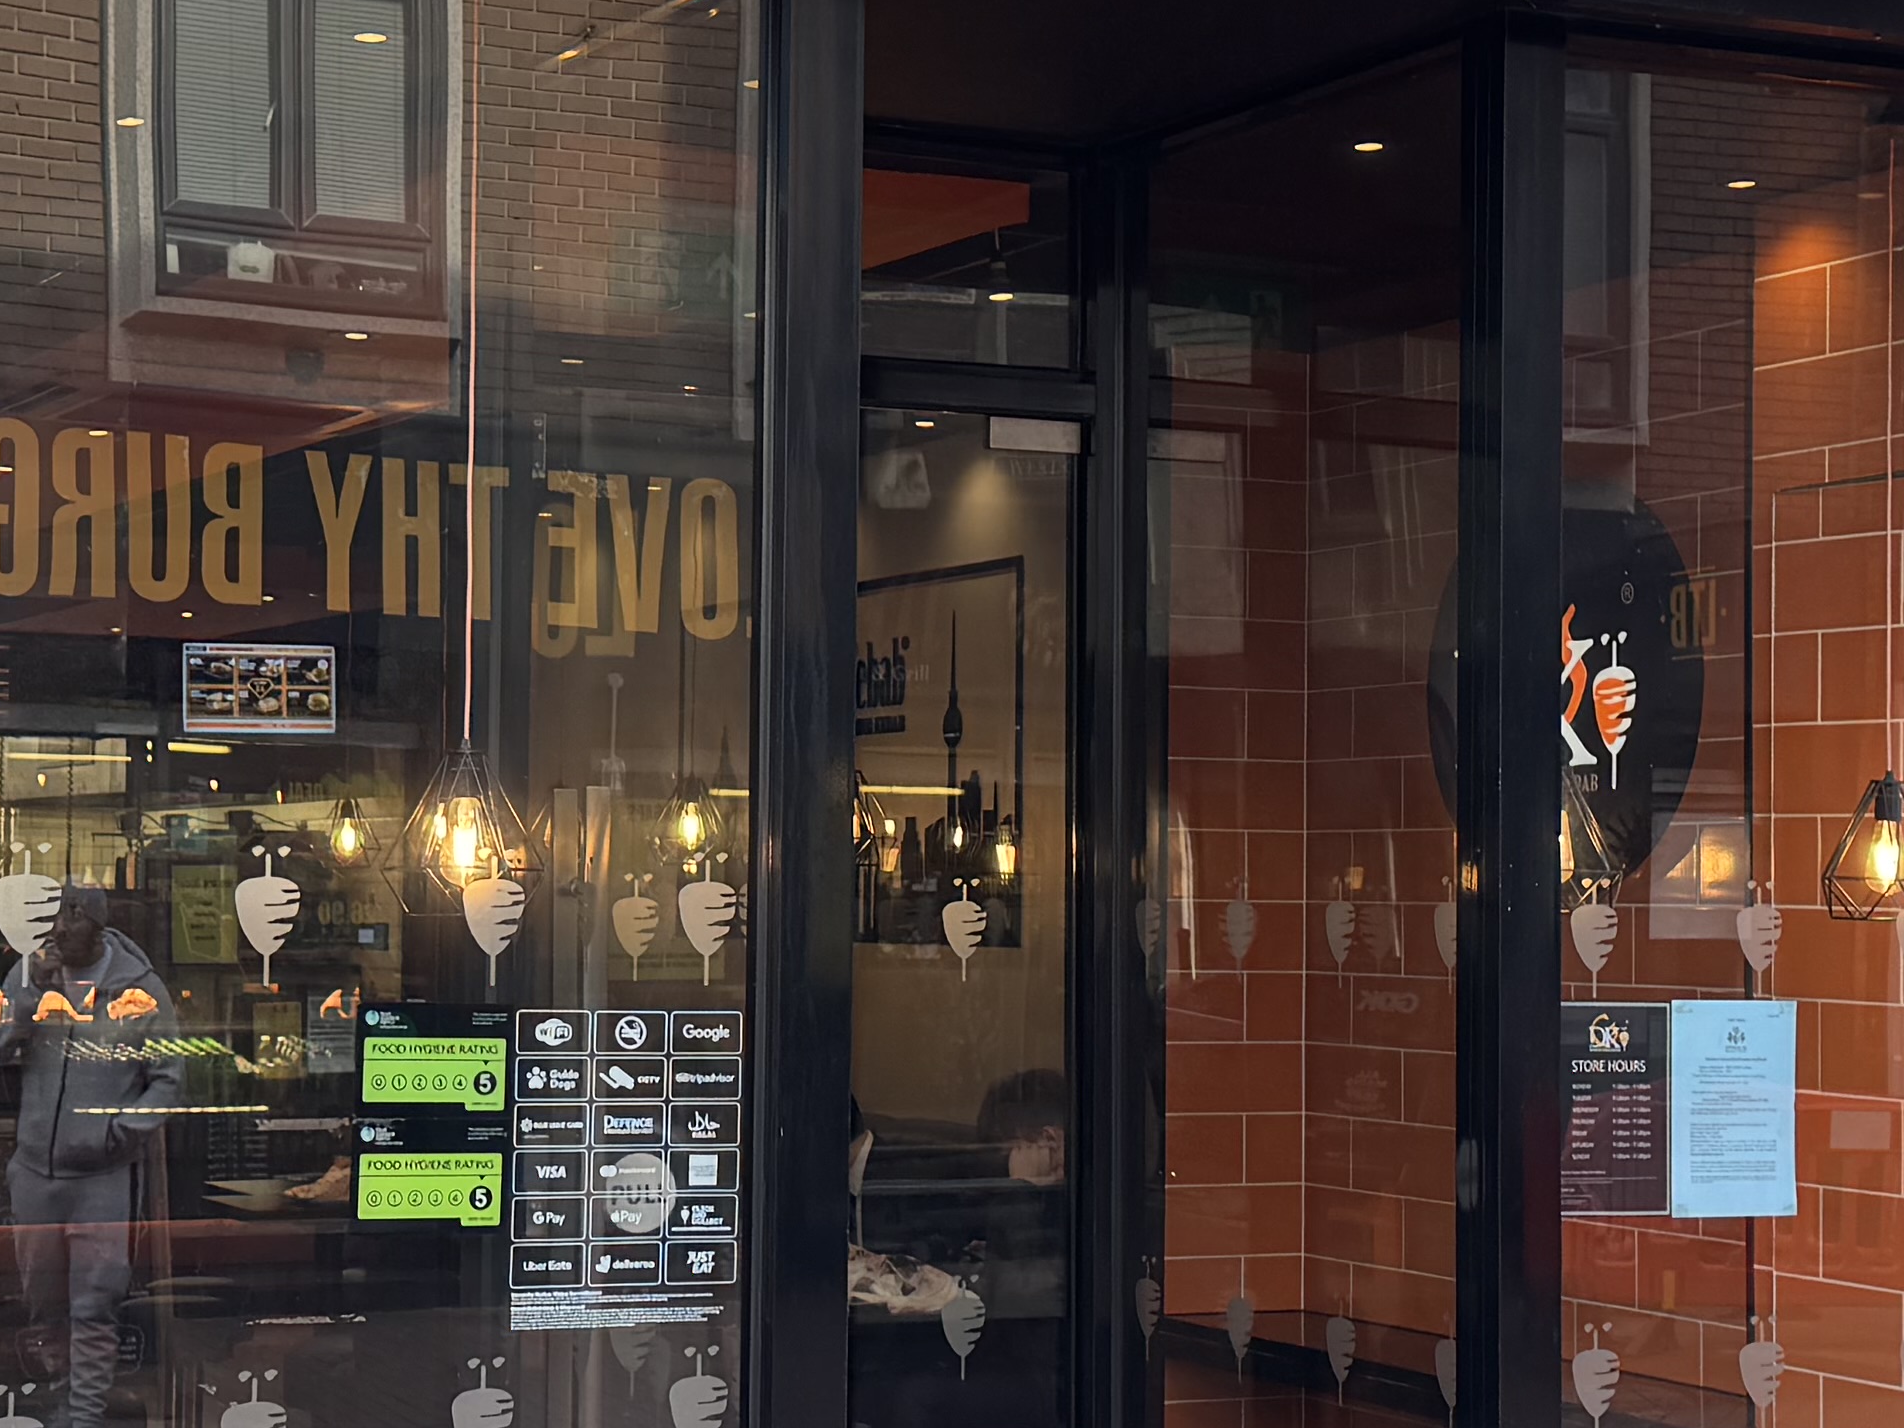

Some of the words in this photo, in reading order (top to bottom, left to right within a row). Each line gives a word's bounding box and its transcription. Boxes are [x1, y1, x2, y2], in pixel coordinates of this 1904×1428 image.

[682, 1023, 731, 1043] Google
[1571, 1059, 1606, 1073] STORE
[1607, 1059, 1647, 1073] HOURS
[478, 1073, 492, 1093] 5
[549, 1079, 577, 1091] Dogs
[368, 1159, 402, 1171] FOOD
[536, 1165, 567, 1179] VISA
[474, 1188, 488, 1208] 5
[546, 1211, 566, 1226] Pay
[620, 1210, 642, 1225] Pay
[687, 1250, 716, 1265] JUST
[523, 1260, 547, 1272] Uber
[691, 1262, 716, 1274] EAT
